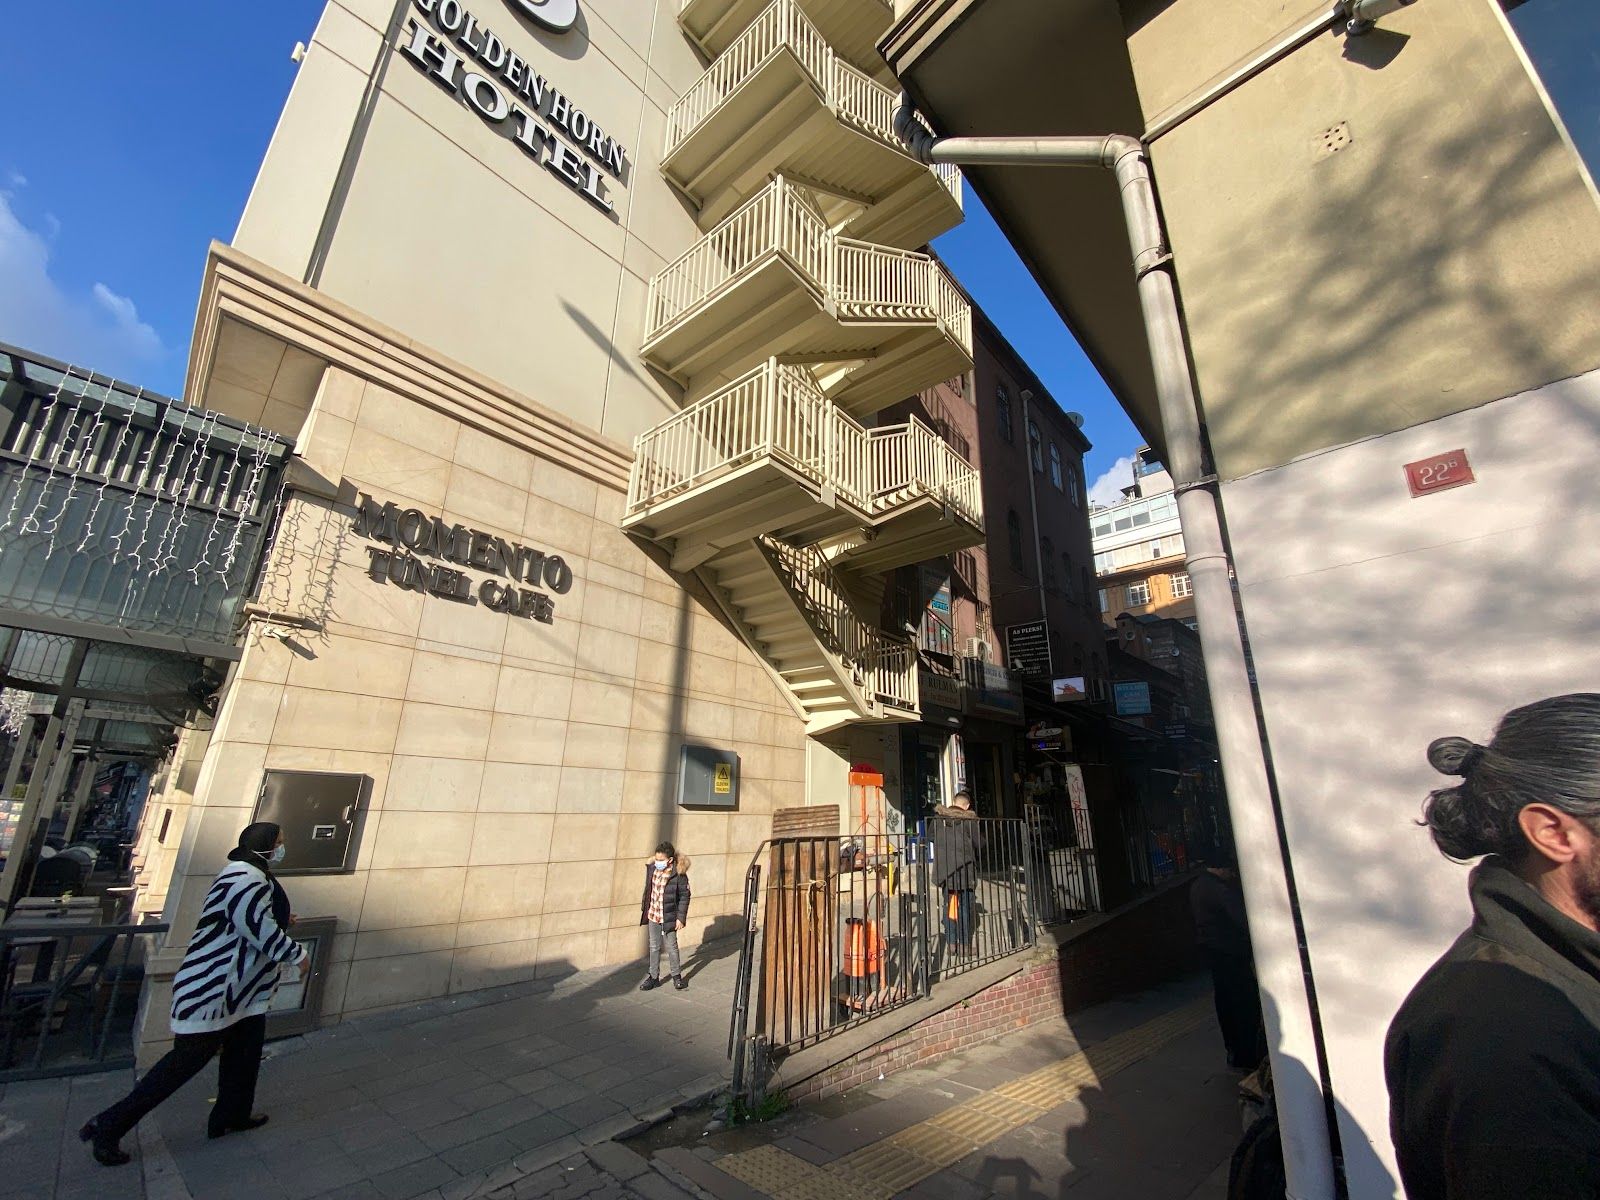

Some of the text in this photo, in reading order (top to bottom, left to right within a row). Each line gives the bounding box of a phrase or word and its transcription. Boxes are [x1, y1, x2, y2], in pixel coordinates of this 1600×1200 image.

[400, 17, 614, 214] HOTEL
[546, 88, 627, 177] HORN
[350, 491, 572, 593] MOMENTO
